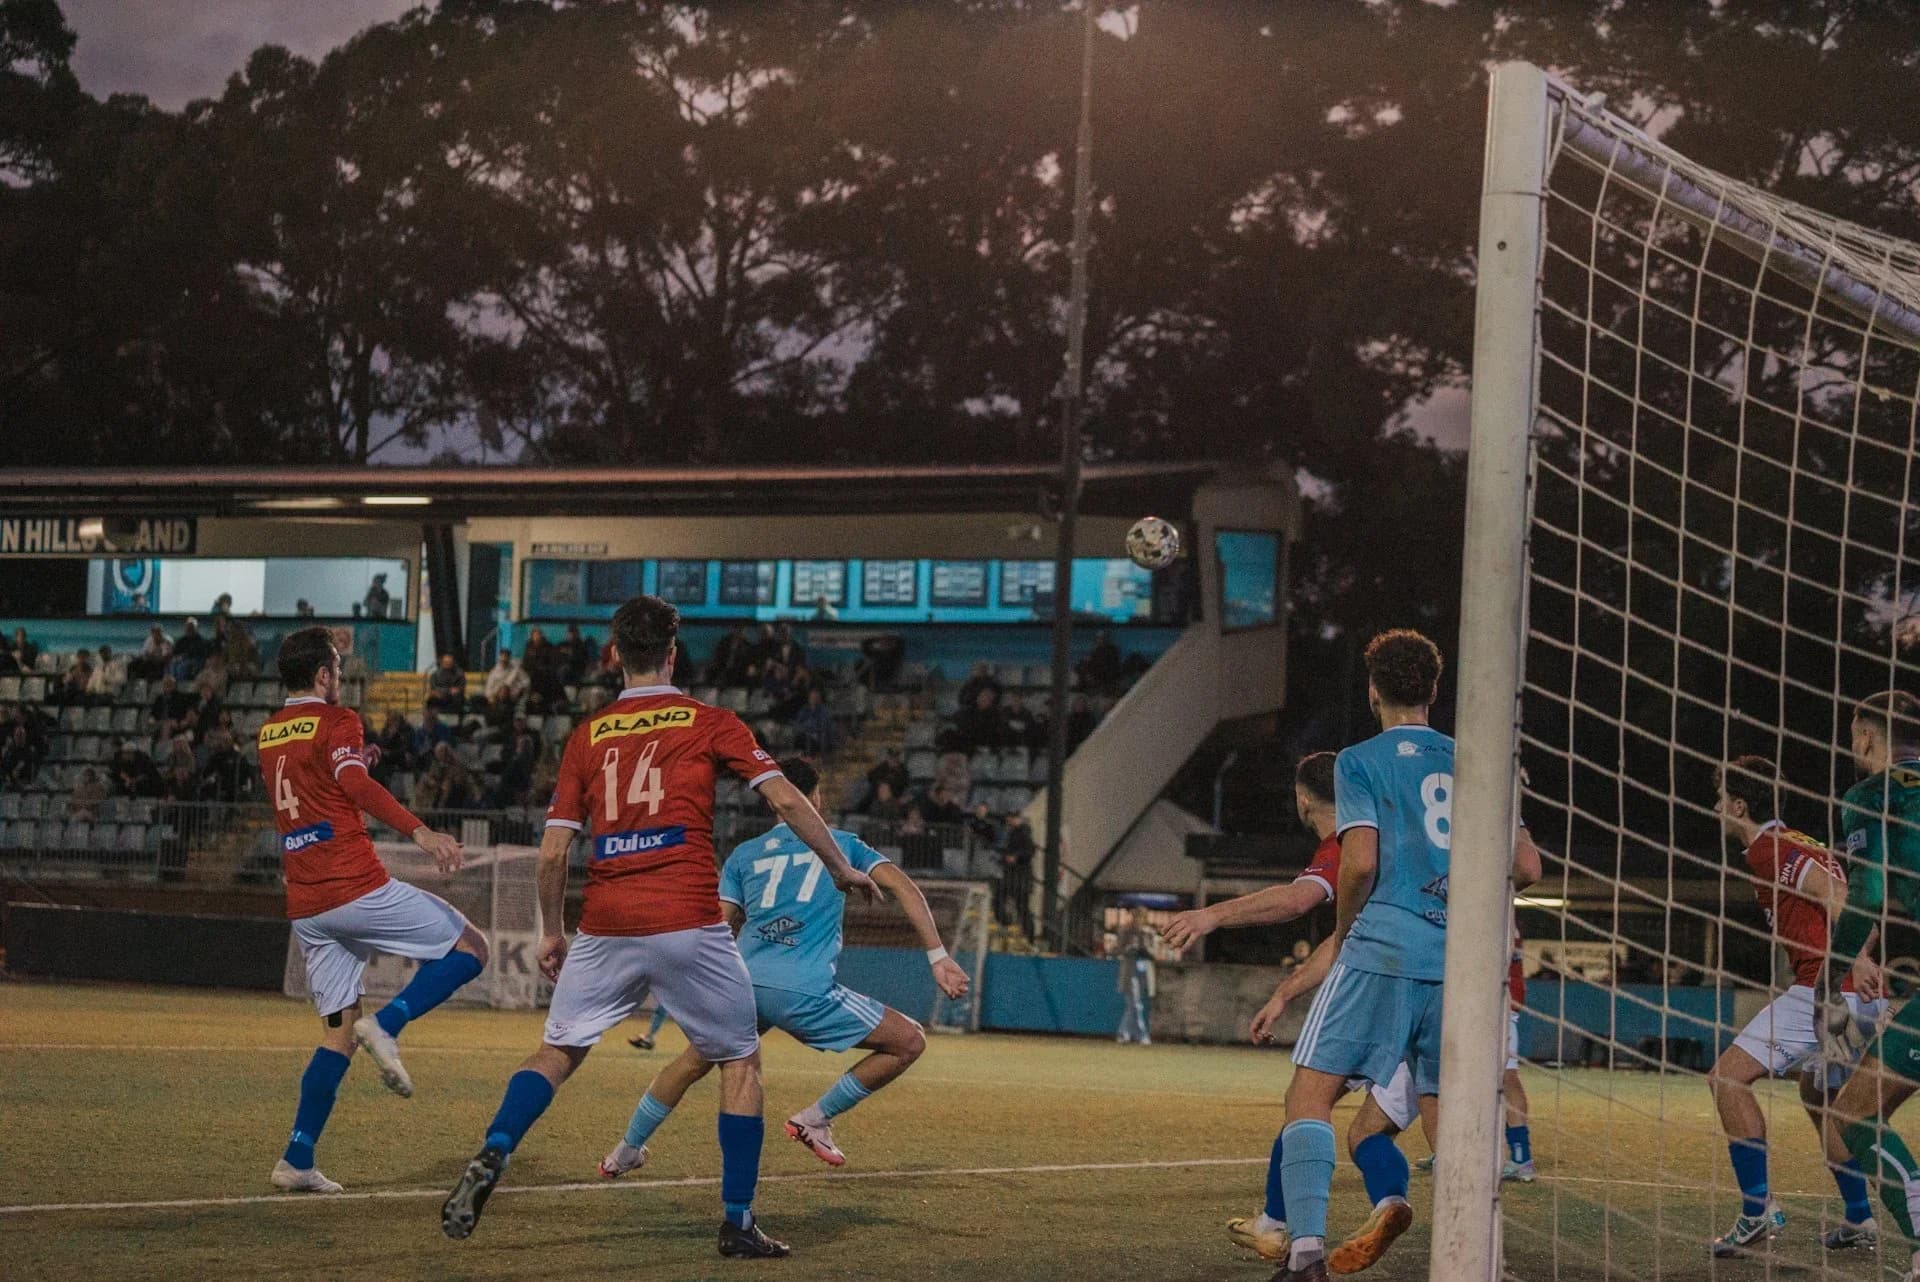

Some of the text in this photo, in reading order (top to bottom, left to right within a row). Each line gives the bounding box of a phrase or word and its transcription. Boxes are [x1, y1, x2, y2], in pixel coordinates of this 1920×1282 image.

[102, 519, 191, 553] AND
[261, 721, 315, 743] ALAND
[593, 711, 691, 739] ALAND
[275, 754, 300, 820] 4
[601, 740, 665, 821] 14
[1420, 772, 1454, 850] 8
[604, 833, 668, 855] Dulux
[753, 851, 825, 909] 77
